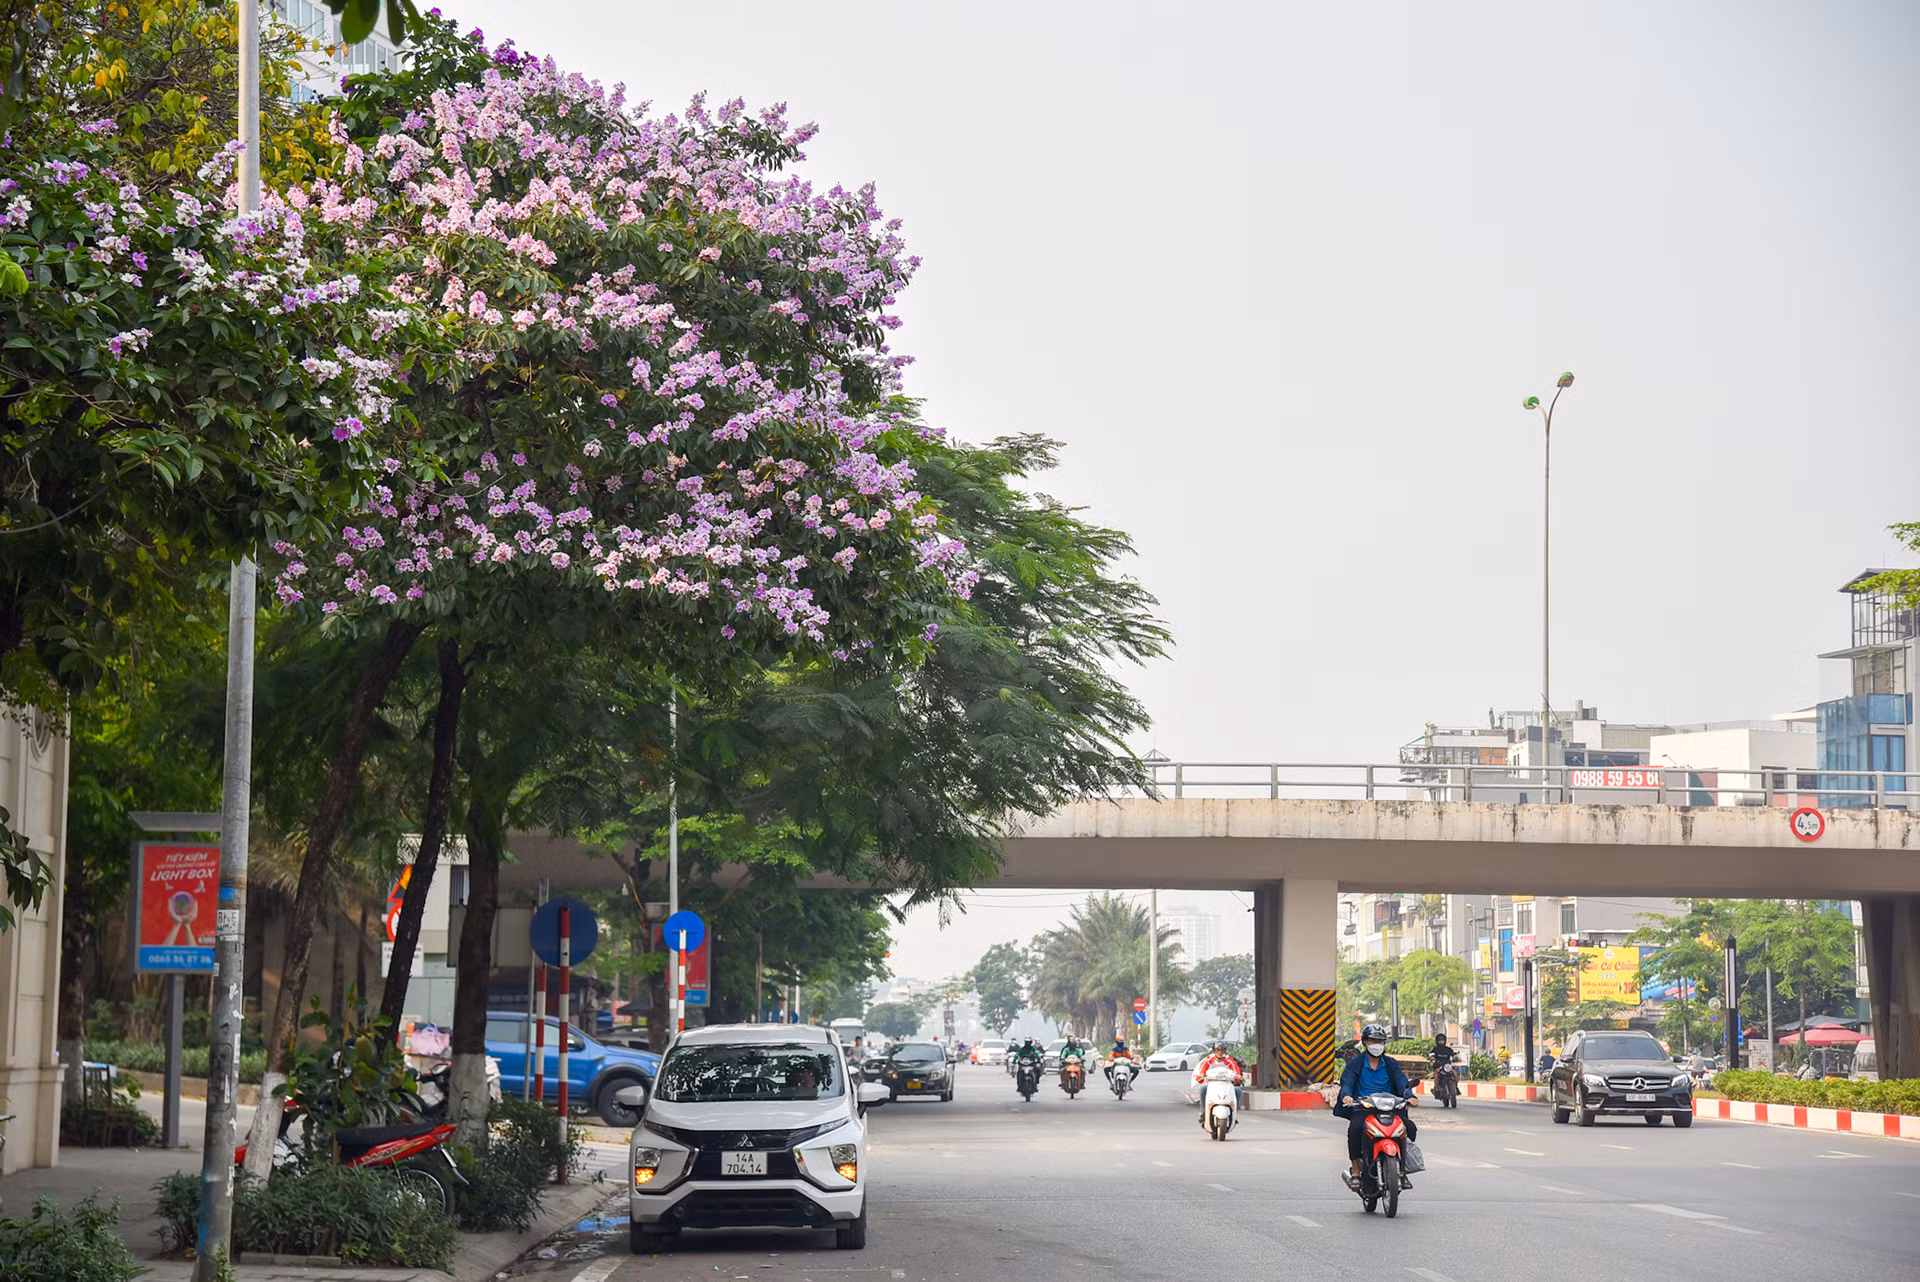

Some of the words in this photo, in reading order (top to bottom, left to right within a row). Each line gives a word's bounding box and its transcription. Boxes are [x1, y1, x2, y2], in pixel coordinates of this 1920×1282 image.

[1573, 770, 1604, 786] 0988
[1607, 770, 1623, 786] 59
[1627, 770, 1643, 786] 55
[150, 870, 188, 881] LIGHT
[188, 868, 215, 879] BOX
[735, 1153, 754, 1163] 14A
[726, 1163, 762, 1174] 704.14
